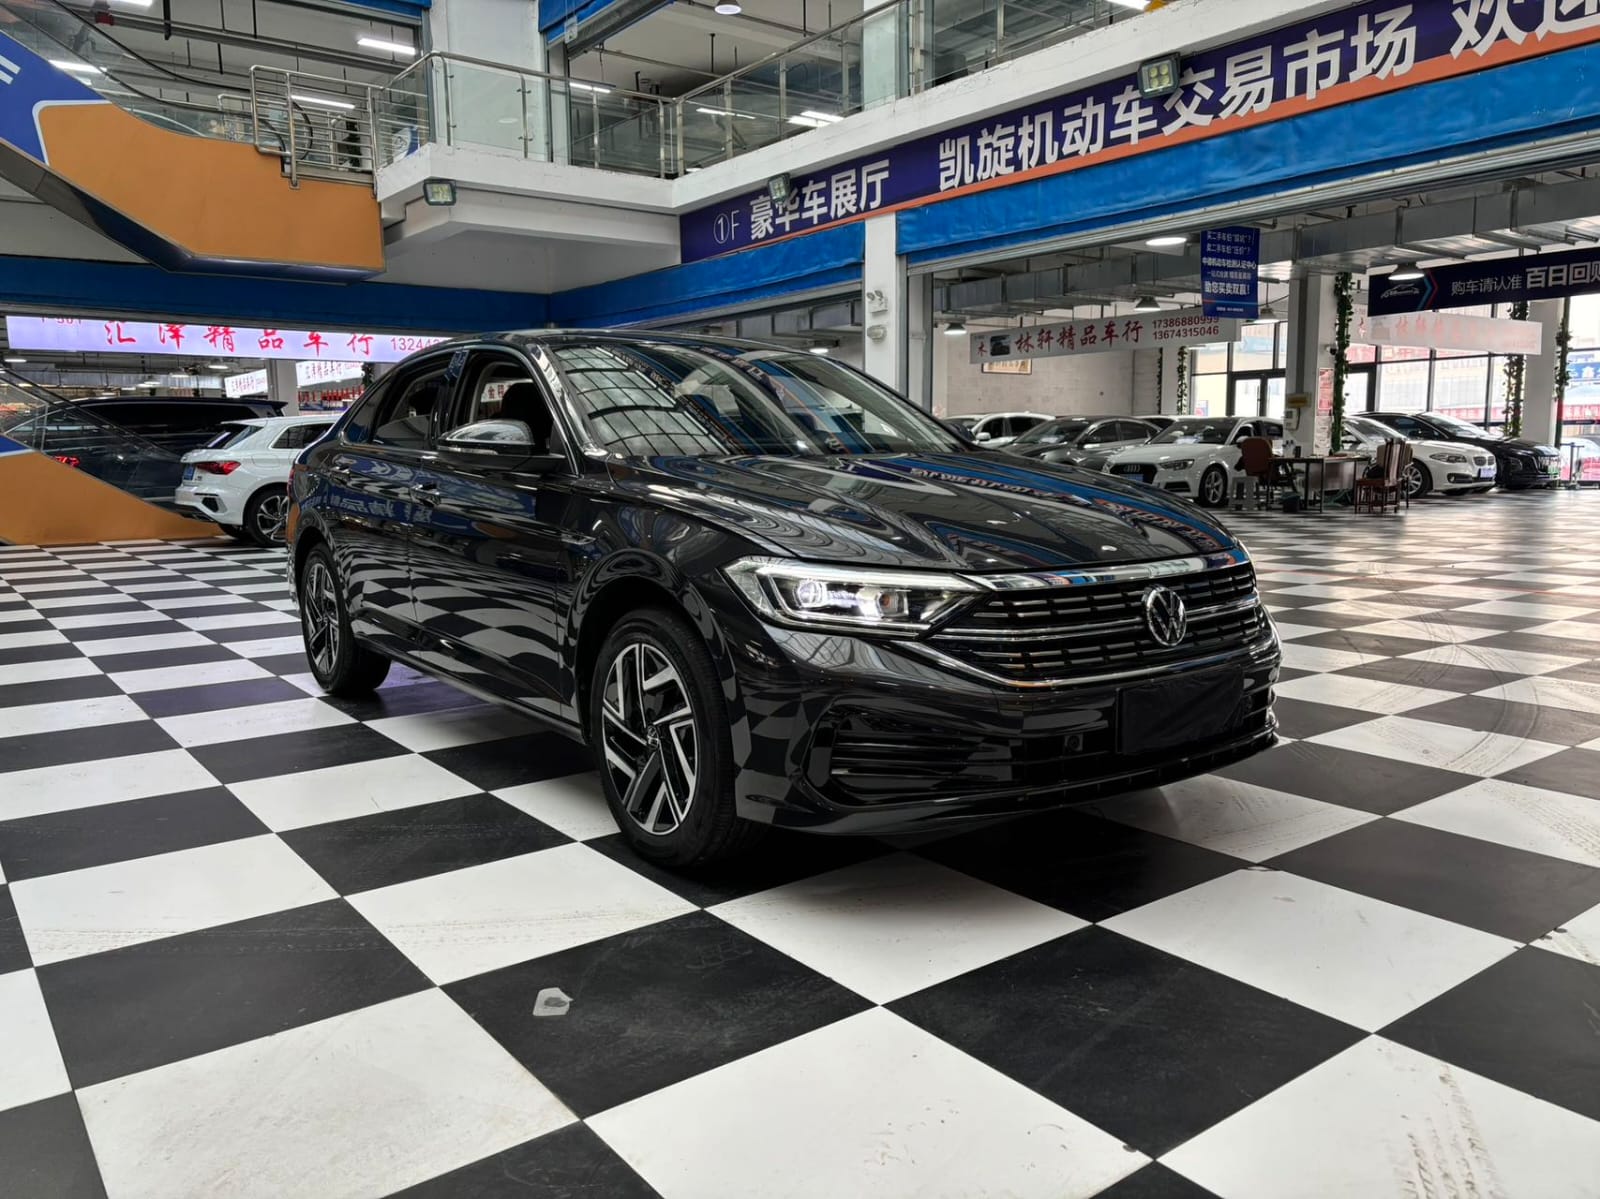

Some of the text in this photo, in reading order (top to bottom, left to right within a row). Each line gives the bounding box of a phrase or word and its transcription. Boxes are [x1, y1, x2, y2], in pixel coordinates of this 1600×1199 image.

[938, 4, 1417, 192] 凯旋机动车交易市场
[750, 159, 890, 241] 豪华车展厅
[1451, 274, 1522, 297] 购车请认准
[104, 320, 374, 357] 汇泽精品车行
[1014, 320, 1144, 353] 林轩精品车行
[1153, 325, 1219, 340] 13674315046
